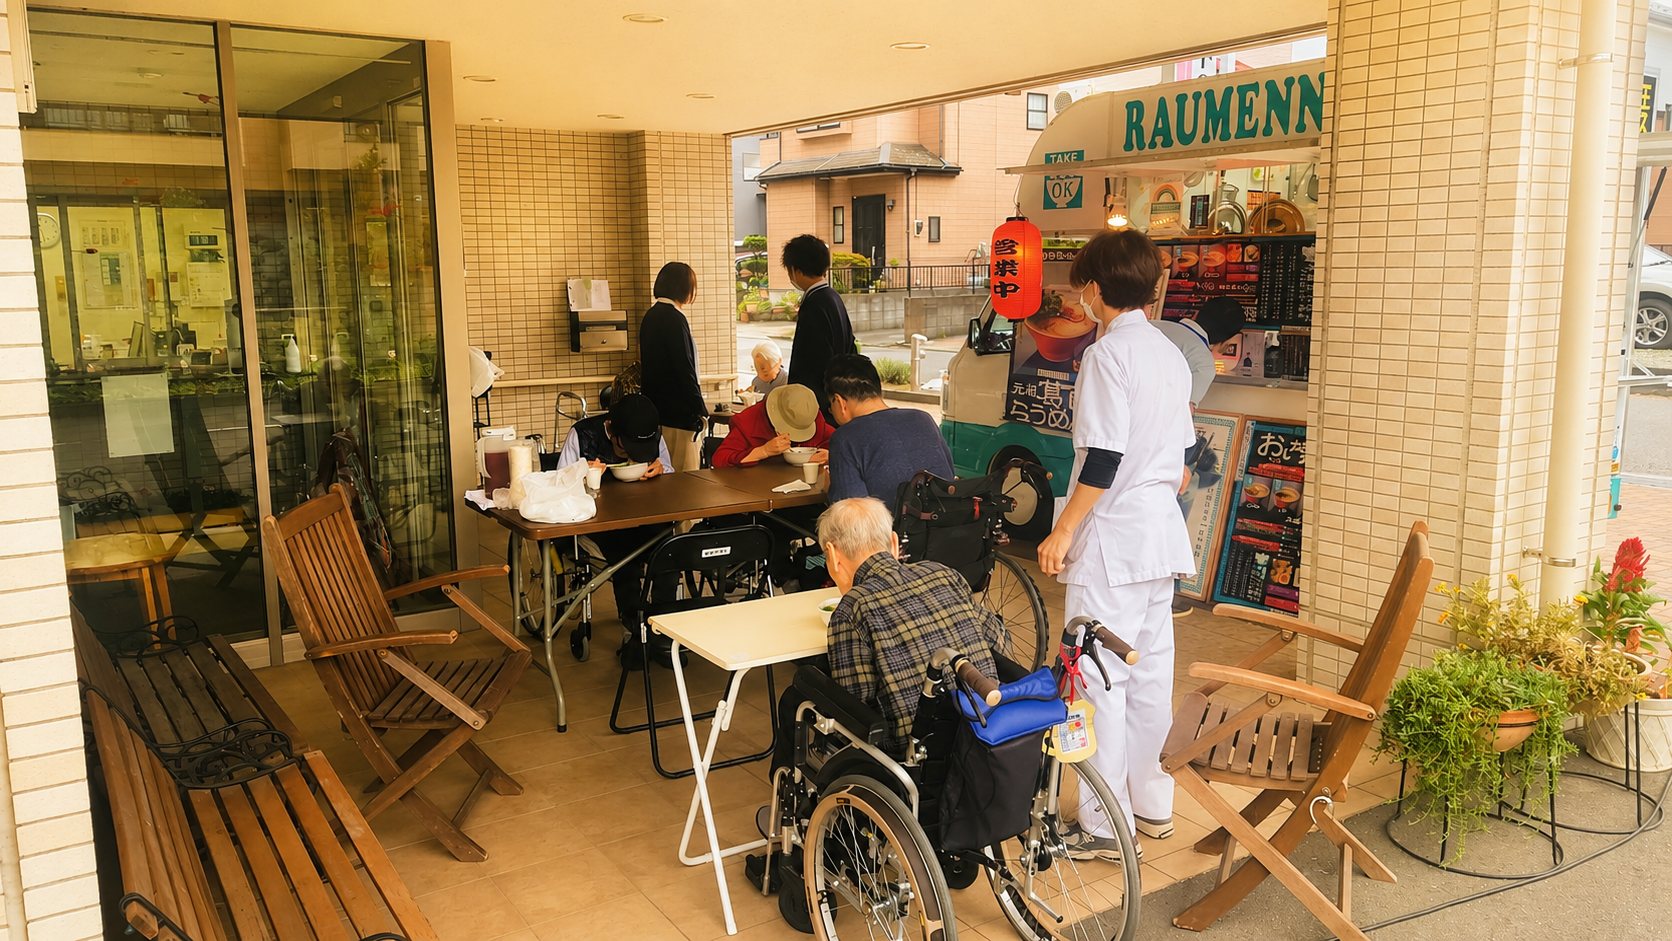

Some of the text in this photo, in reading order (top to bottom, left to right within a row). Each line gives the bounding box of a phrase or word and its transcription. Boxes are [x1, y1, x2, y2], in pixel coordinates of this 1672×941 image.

[1123, 72, 1325, 151] RAUMENN
[1049, 152, 1078, 164] TAKE
[1051, 182, 1074, 199] OK
